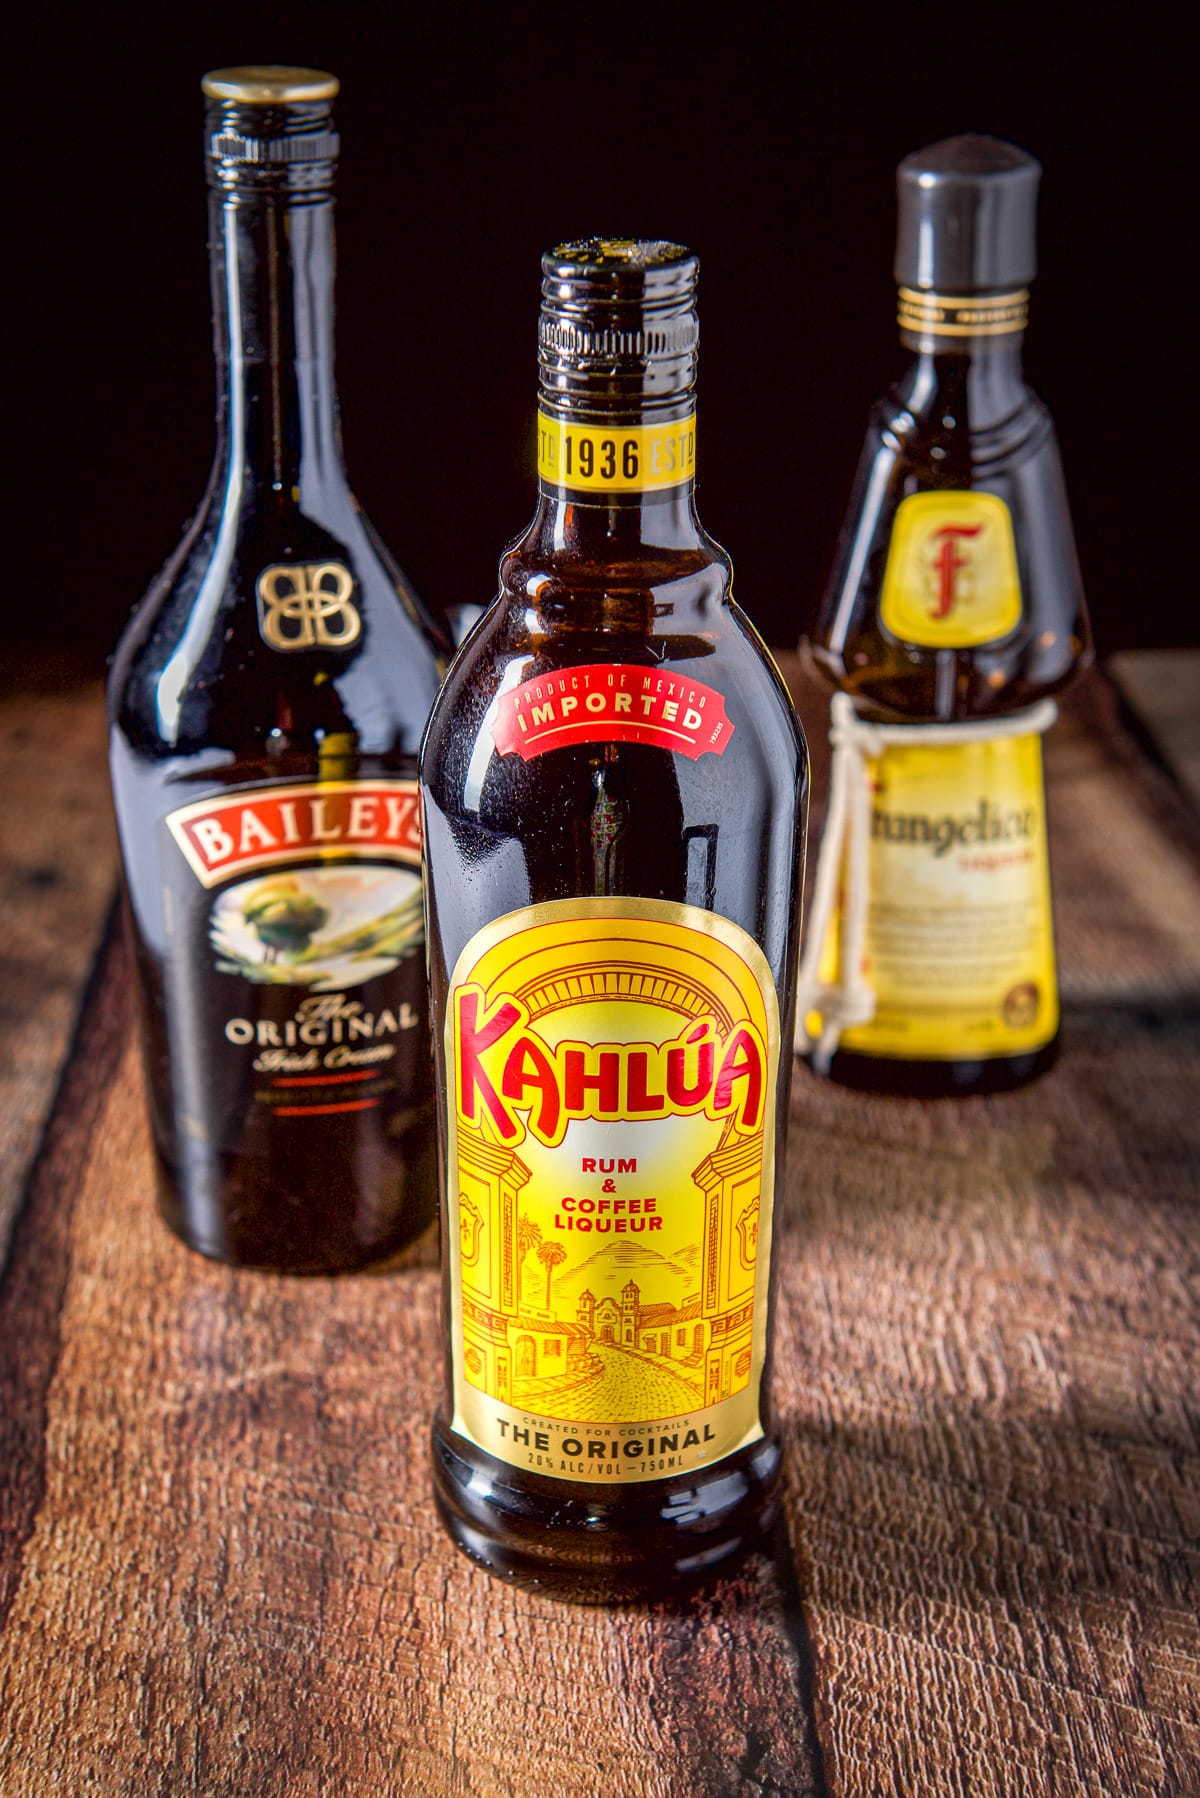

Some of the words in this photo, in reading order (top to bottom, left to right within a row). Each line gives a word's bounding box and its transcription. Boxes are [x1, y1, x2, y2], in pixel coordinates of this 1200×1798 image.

[565, 436, 638, 479] 1936
[651, 432, 693, 473] ESTD
[929, 522, 985, 622] F
[514, 675, 590, 708] PRODUCT
[607, 674, 626, 686] OF
[643, 677, 706, 708] MEXICO
[517, 692, 702, 732] IMPORTED
[295, 993, 364, 1022] The
[225, 1002, 418, 1046] ORIGINAL
[459, 992, 761, 1139] KAHLÚA
[581, 1157, 637, 1173] RUM
[601, 1178, 617, 1193] &
[561, 1197, 656, 1214] COFFEE
[554, 1214, 663, 1233] LIQUEUR
[496, 1418, 549, 1451] THE
[561, 1424, 715, 1459] ORIGINAL
[523, 1417, 578, 1434] CREATED
[586, 1428, 611, 1436] FOR
[619, 1420, 689, 1436] COCKTAILS
[528, 1453, 553, 1468] 20%
